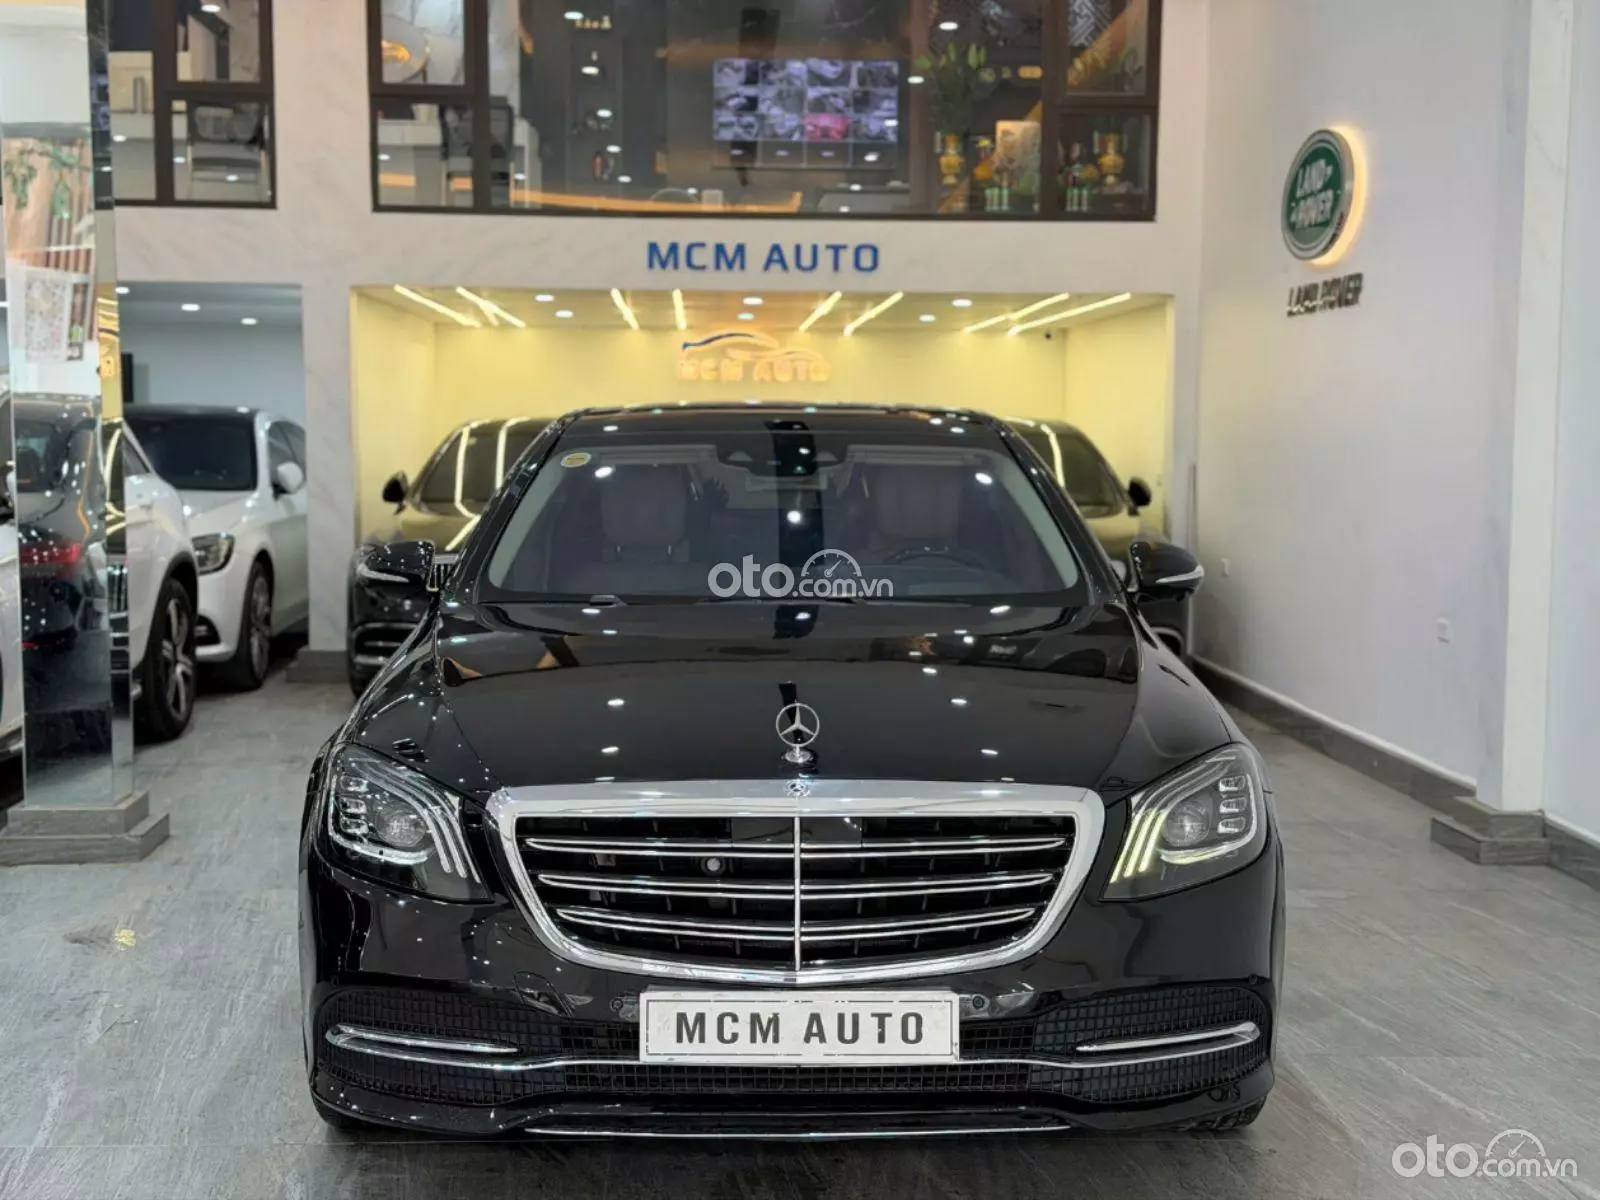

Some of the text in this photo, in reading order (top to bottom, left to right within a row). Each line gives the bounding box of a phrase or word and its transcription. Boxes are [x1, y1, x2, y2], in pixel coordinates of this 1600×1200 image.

[647, 241, 880, 273] MCM AUTO
[677, 358, 831, 382] MCM AUTO
[675, 1011, 924, 1045] MCM AUTO
